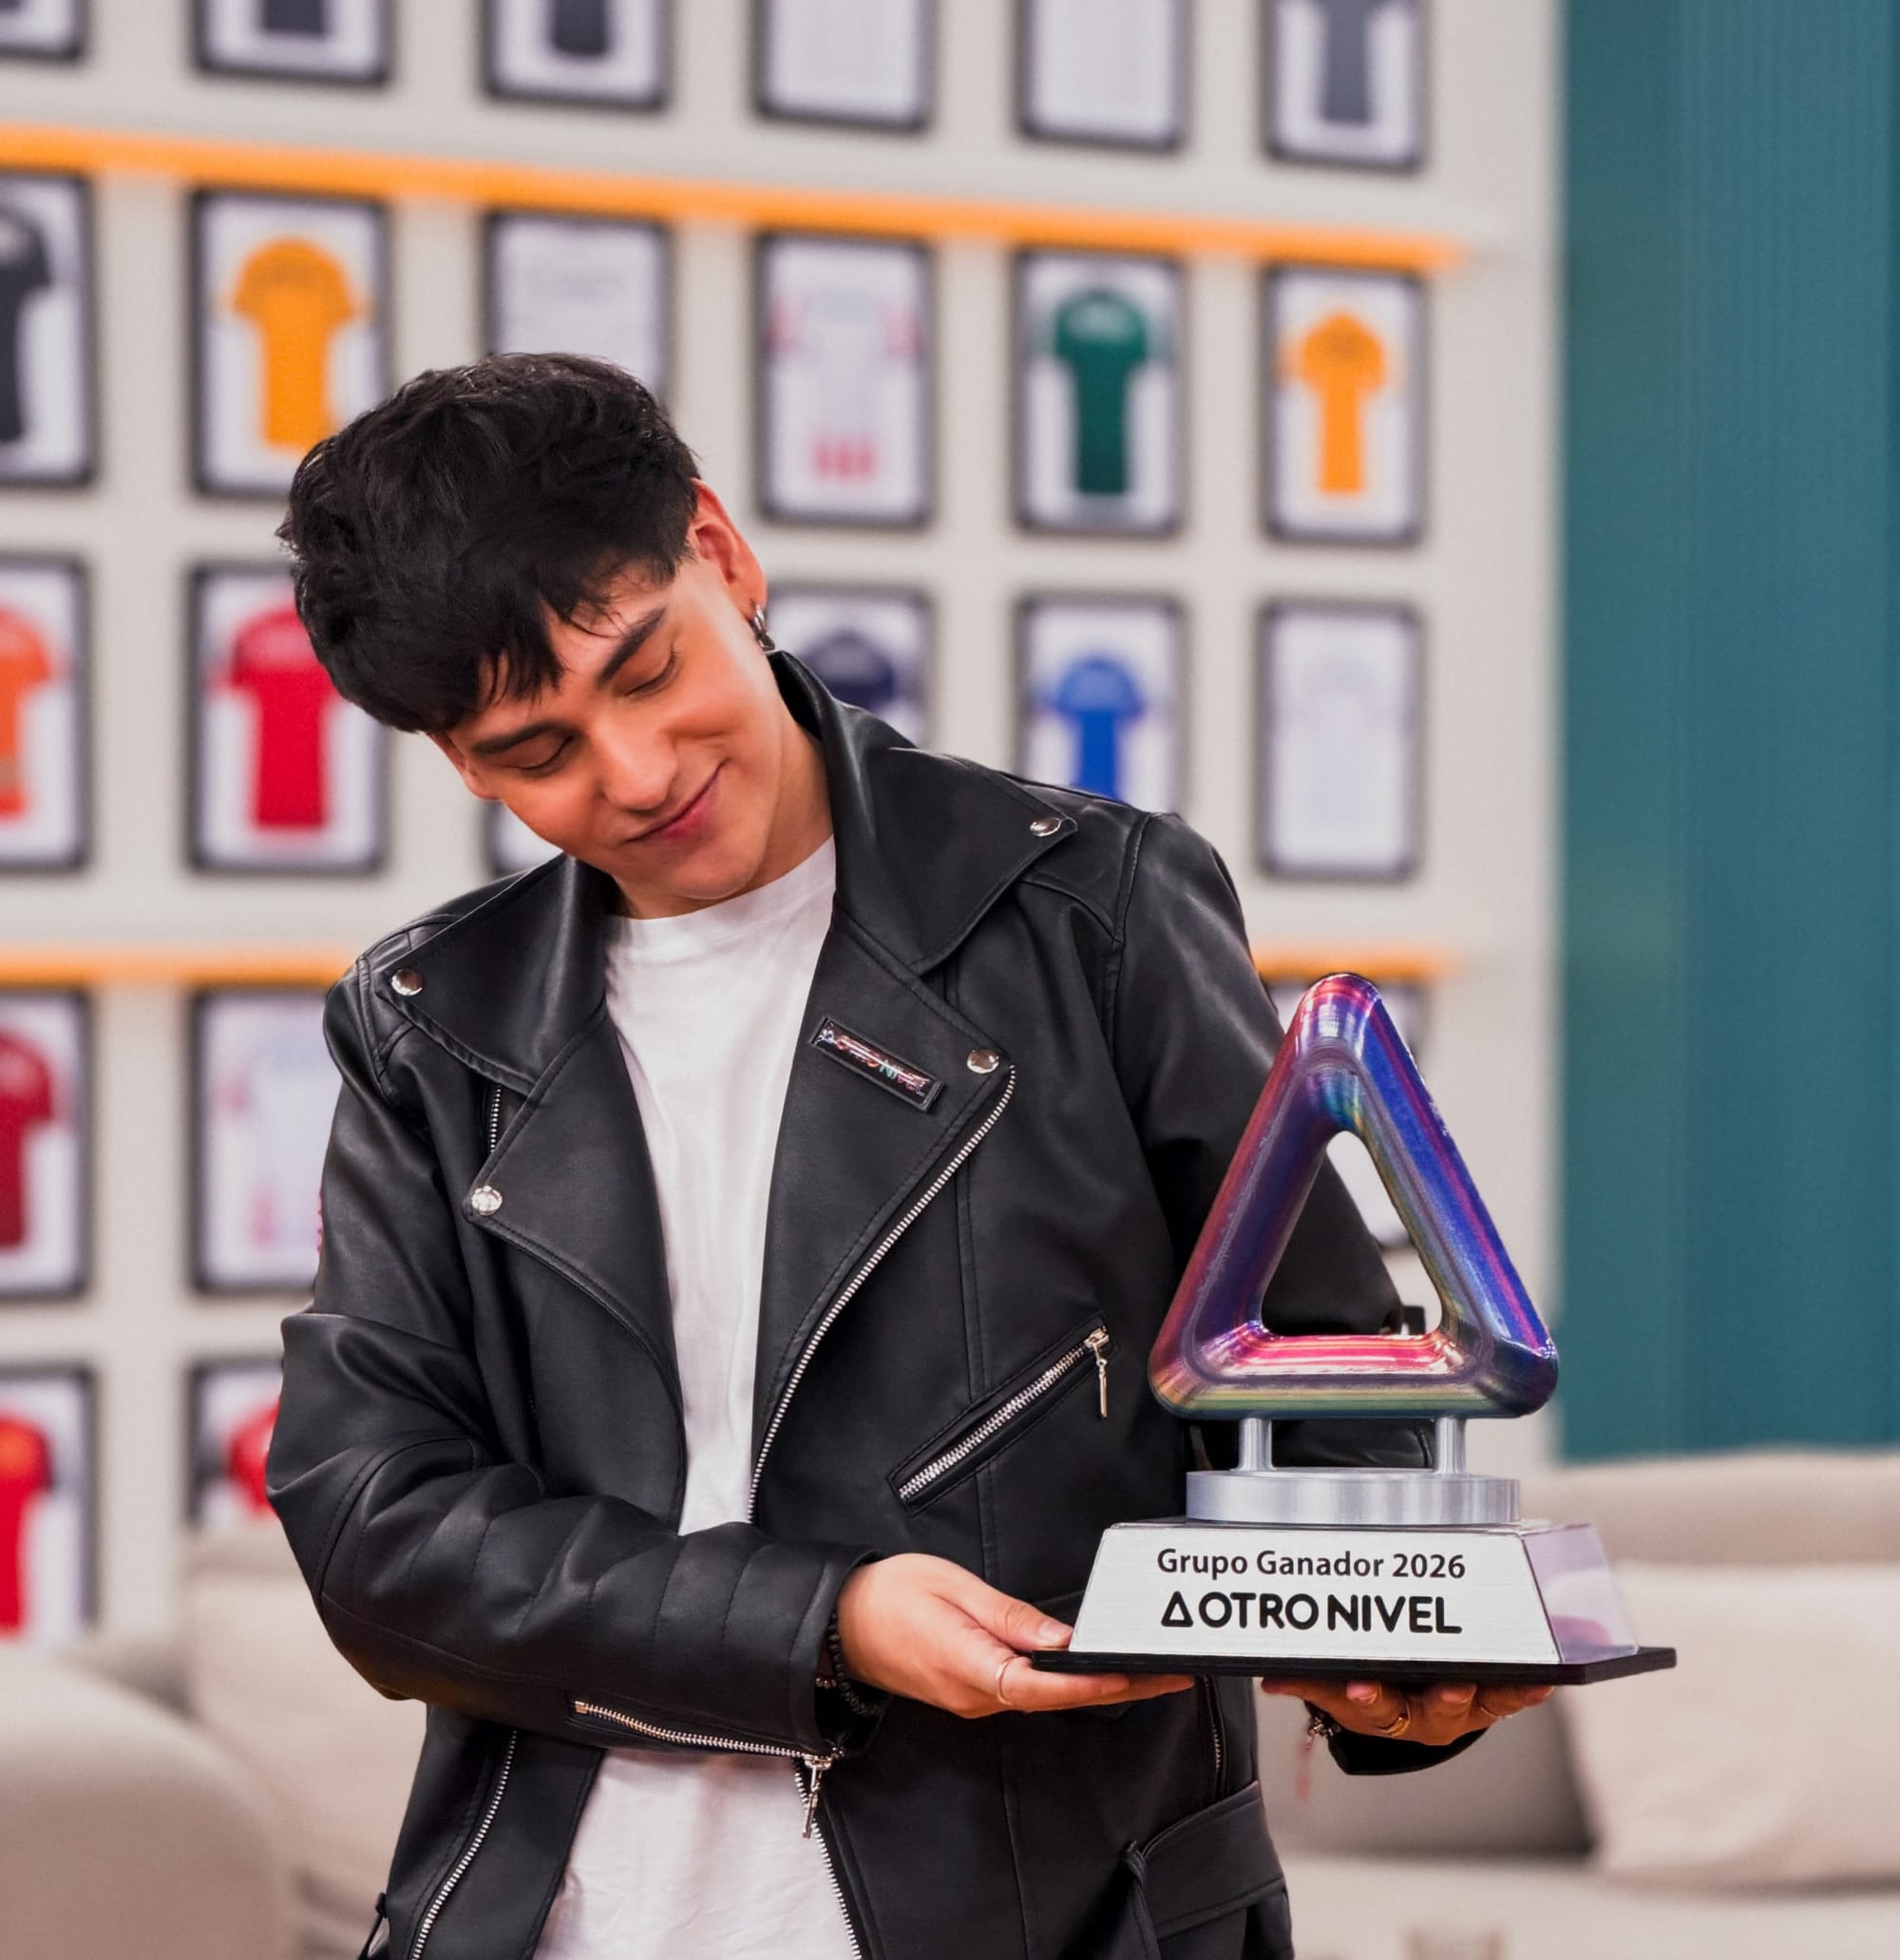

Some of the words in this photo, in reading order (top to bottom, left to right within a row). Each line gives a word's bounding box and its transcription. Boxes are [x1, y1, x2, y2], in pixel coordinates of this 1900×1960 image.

[1157, 1548, 1248, 1581] Grupo
[1256, 1550, 1384, 1577] Ganador
[1393, 1553, 1466, 1579] 2026
[1198, 1591, 1320, 1630] OTRO
[1327, 1594, 1463, 1634] NIVEL
